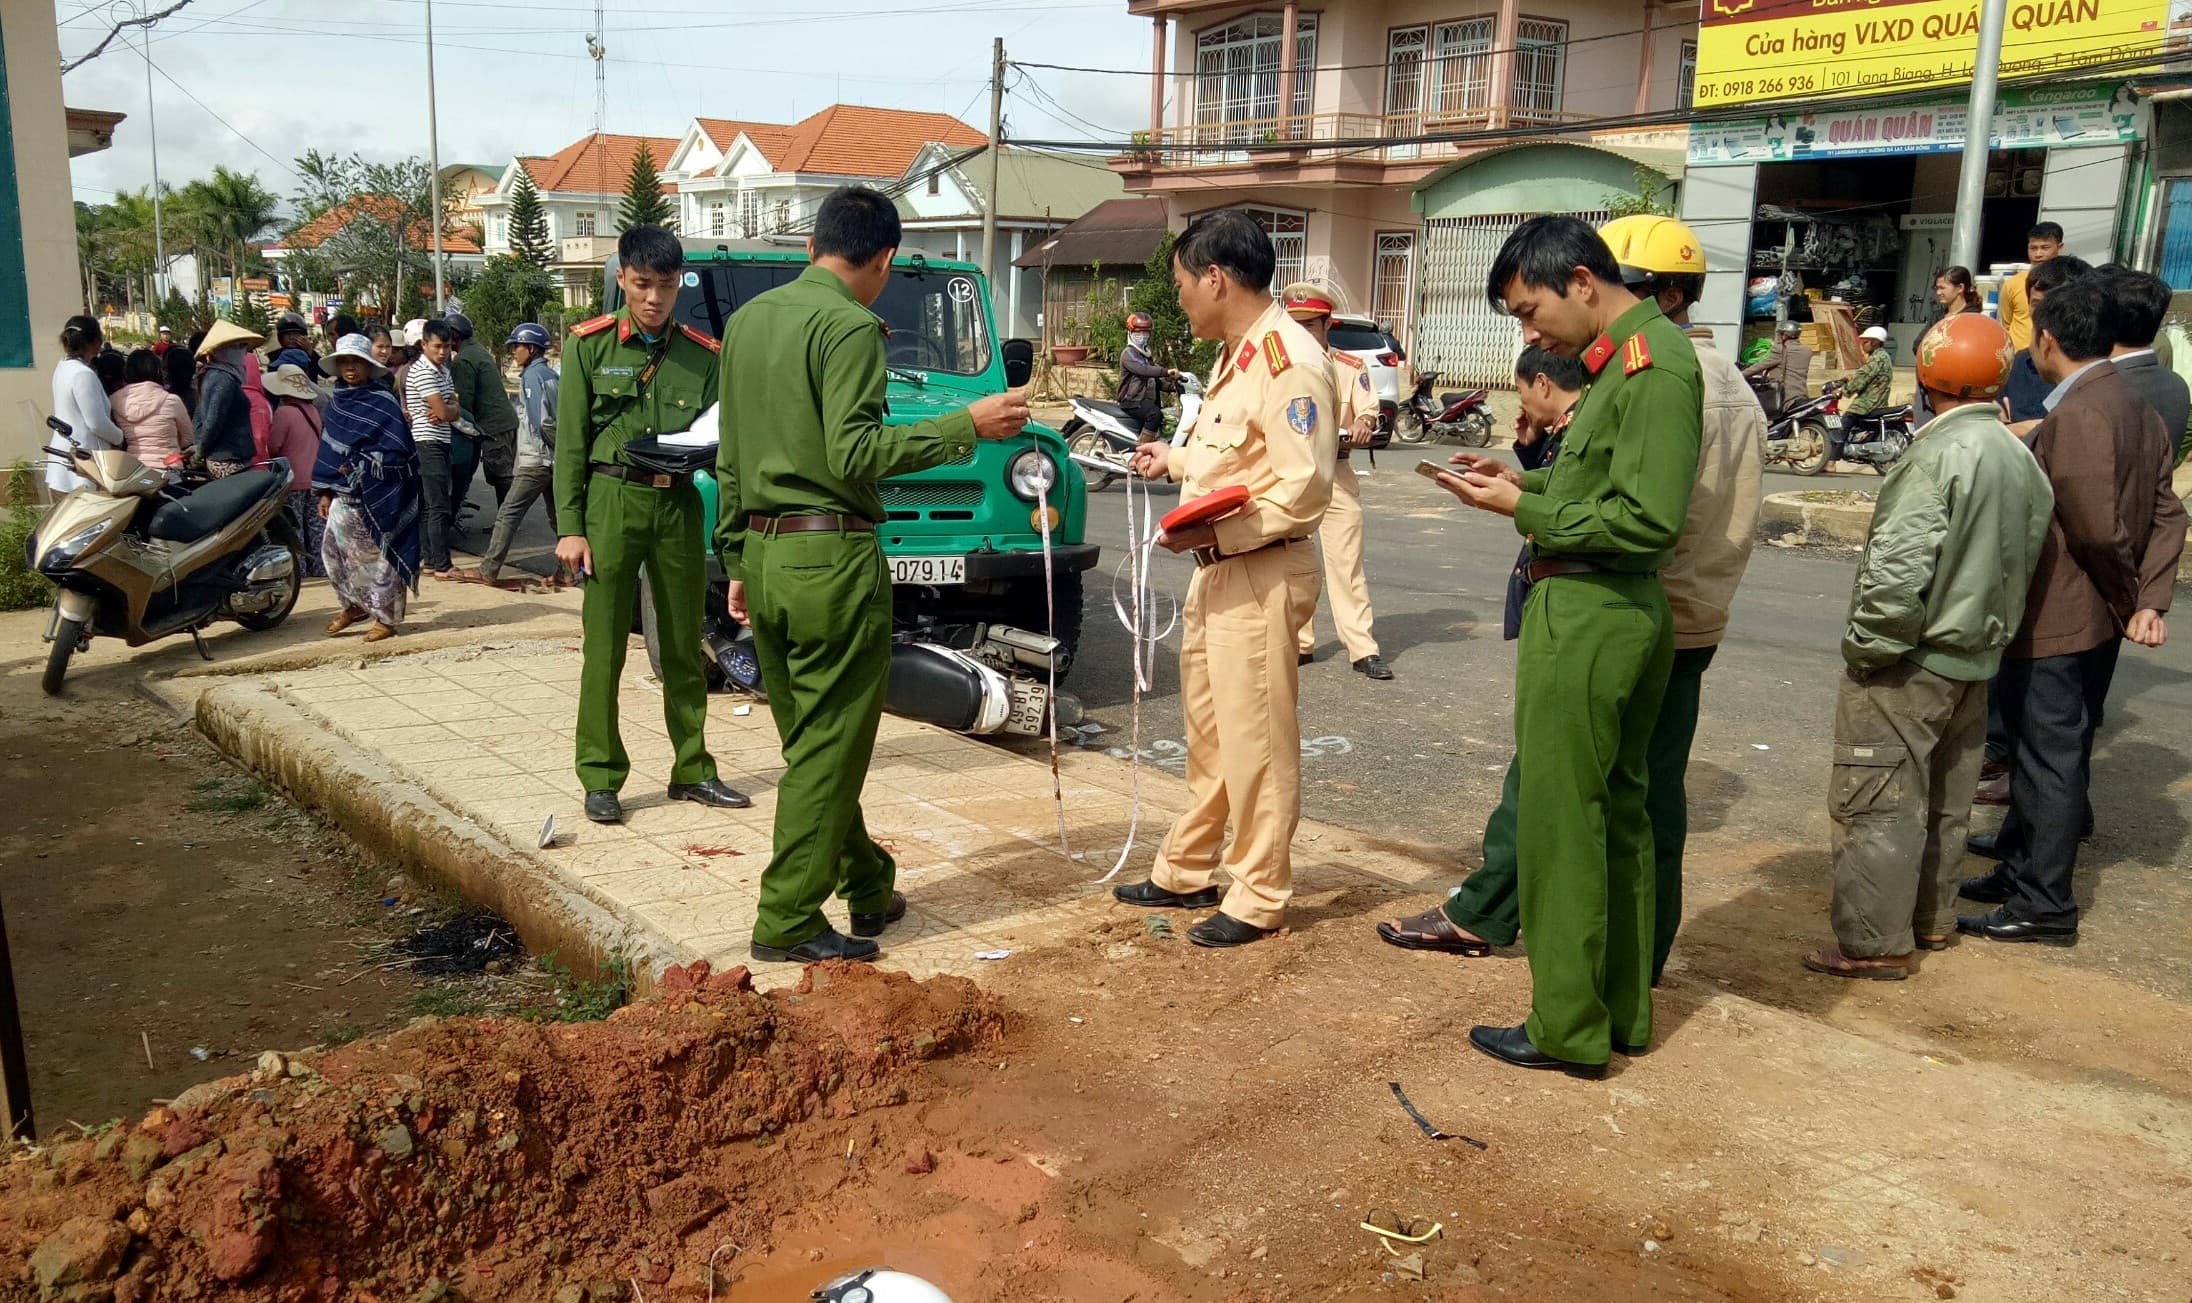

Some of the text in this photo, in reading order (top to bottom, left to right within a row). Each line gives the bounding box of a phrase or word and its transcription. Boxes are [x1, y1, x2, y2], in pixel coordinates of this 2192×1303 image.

[1745, 31, 1785, 56] Cửa
[1792, 28, 1846, 54] hàng
[1855, 18, 1914, 45] VLXD
[1922, 4, 1980, 40] QUÁ
[1699, 75, 1814, 98] ĐT: 0918 266 936
[1831, 71, 1851, 86] 101
[1829, 113, 1878, 145] QUÁN
[1882, 110, 1933, 142] QUÂN
[953, 282, 971, 296] 12
[1023, 686, 1045, 732] 592.39
